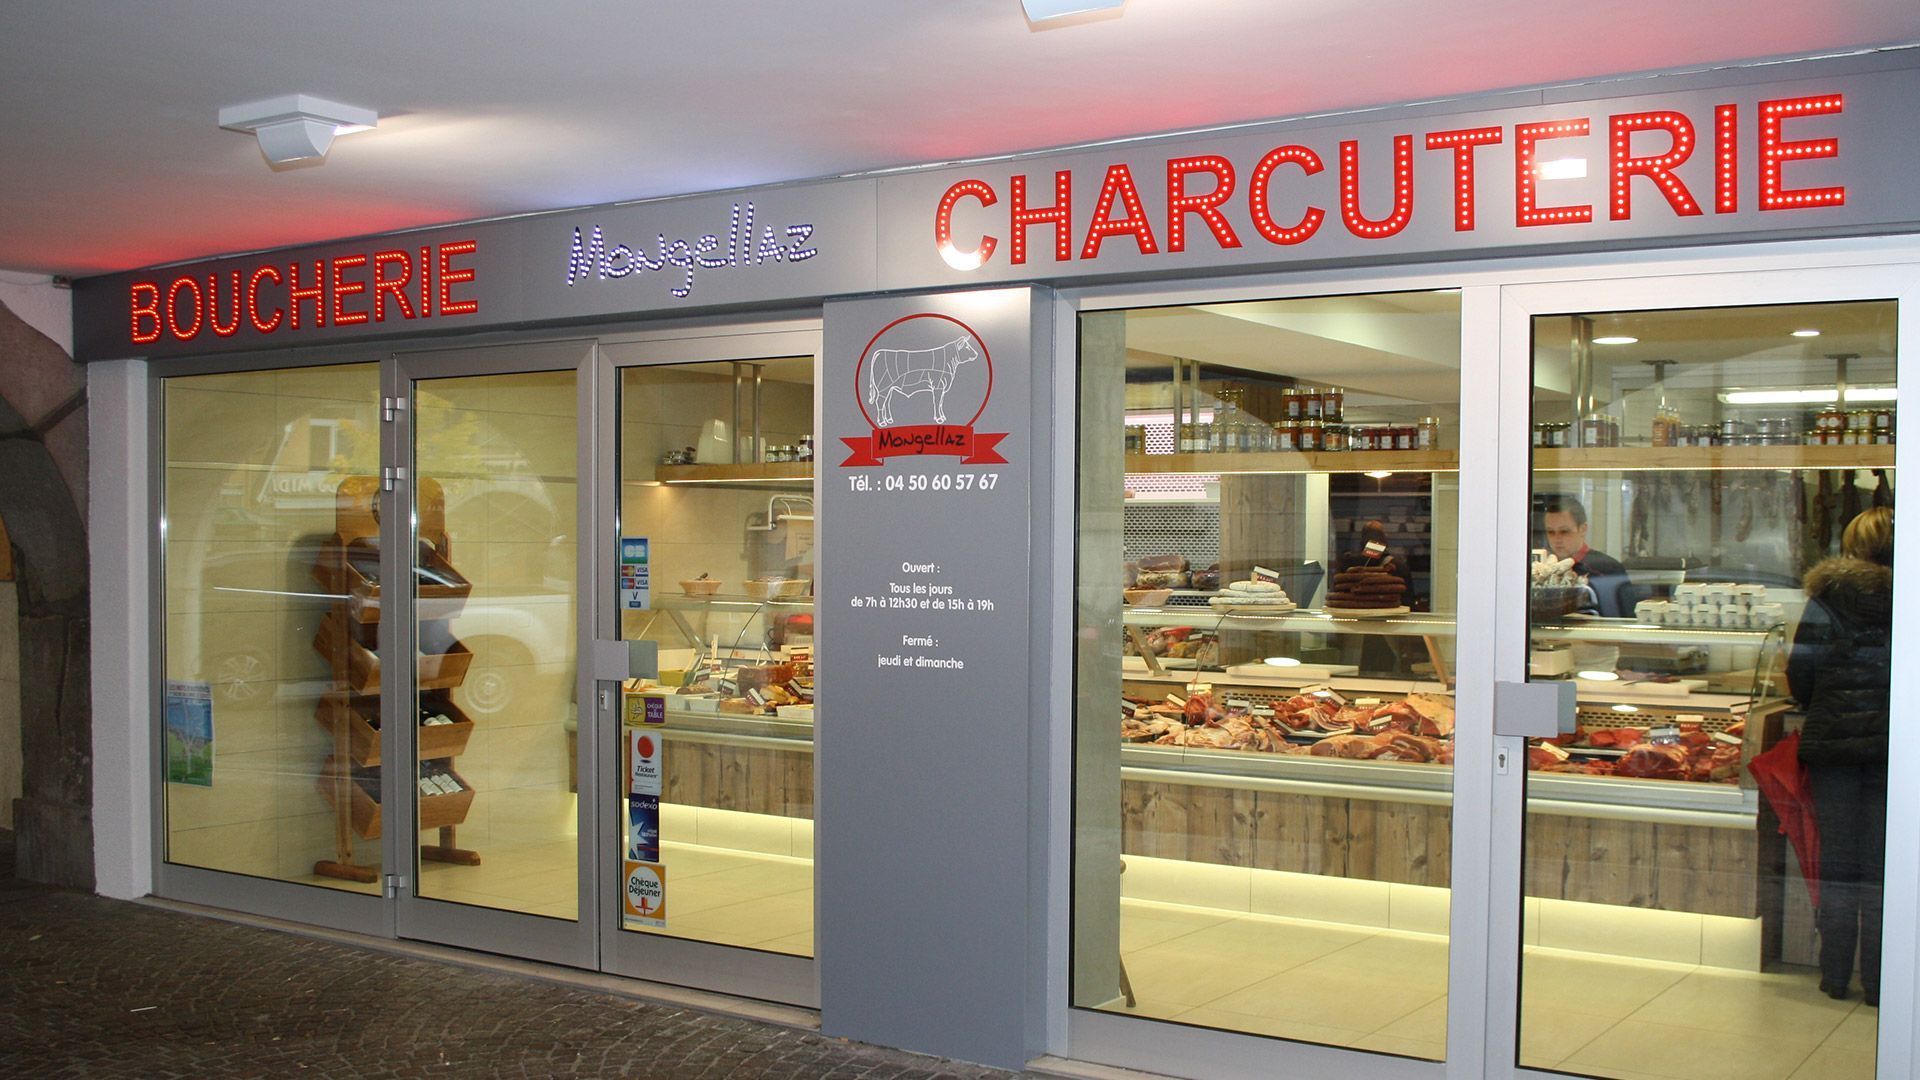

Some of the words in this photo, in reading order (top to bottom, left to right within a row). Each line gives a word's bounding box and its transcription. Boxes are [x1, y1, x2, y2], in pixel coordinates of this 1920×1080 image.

[935, 93, 1846, 272] CHARCUTERIE
[131, 240, 478, 344] BOUCHERIE
[848, 475, 873, 492] Tél.
[885, 475, 905, 491] 04
[908, 475, 928, 491] 50
[932, 474, 951, 491] 60
[955, 474, 975, 490] 57
[979, 474, 999, 490] 67
[902, 562, 934, 573] Ouvert
[889, 582, 910, 595] Tous
[912, 583, 926, 595] les
[928, 584, 953, 597] jours
[851, 595, 864, 608] de
[866, 596, 878, 608] 7h
[880, 596, 887, 608] à
[889, 596, 917, 609] 12h30
[920, 597, 930, 609] et
[932, 597, 945, 610] de
[947, 598, 965, 610] 15h
[967, 598, 975, 611] à
[977, 599, 994, 611] 19h
[903, 634, 932, 647] Fermé
[878, 655, 901, 669] jeudi
[903, 656, 913, 668] et
[915, 656, 964, 670] dimanche
[637, 765, 655, 774] Ticket
[631, 800, 658, 810] sodexo
[631, 876, 659, 889] Chèque
[629, 884, 661, 898] Déjeuner
